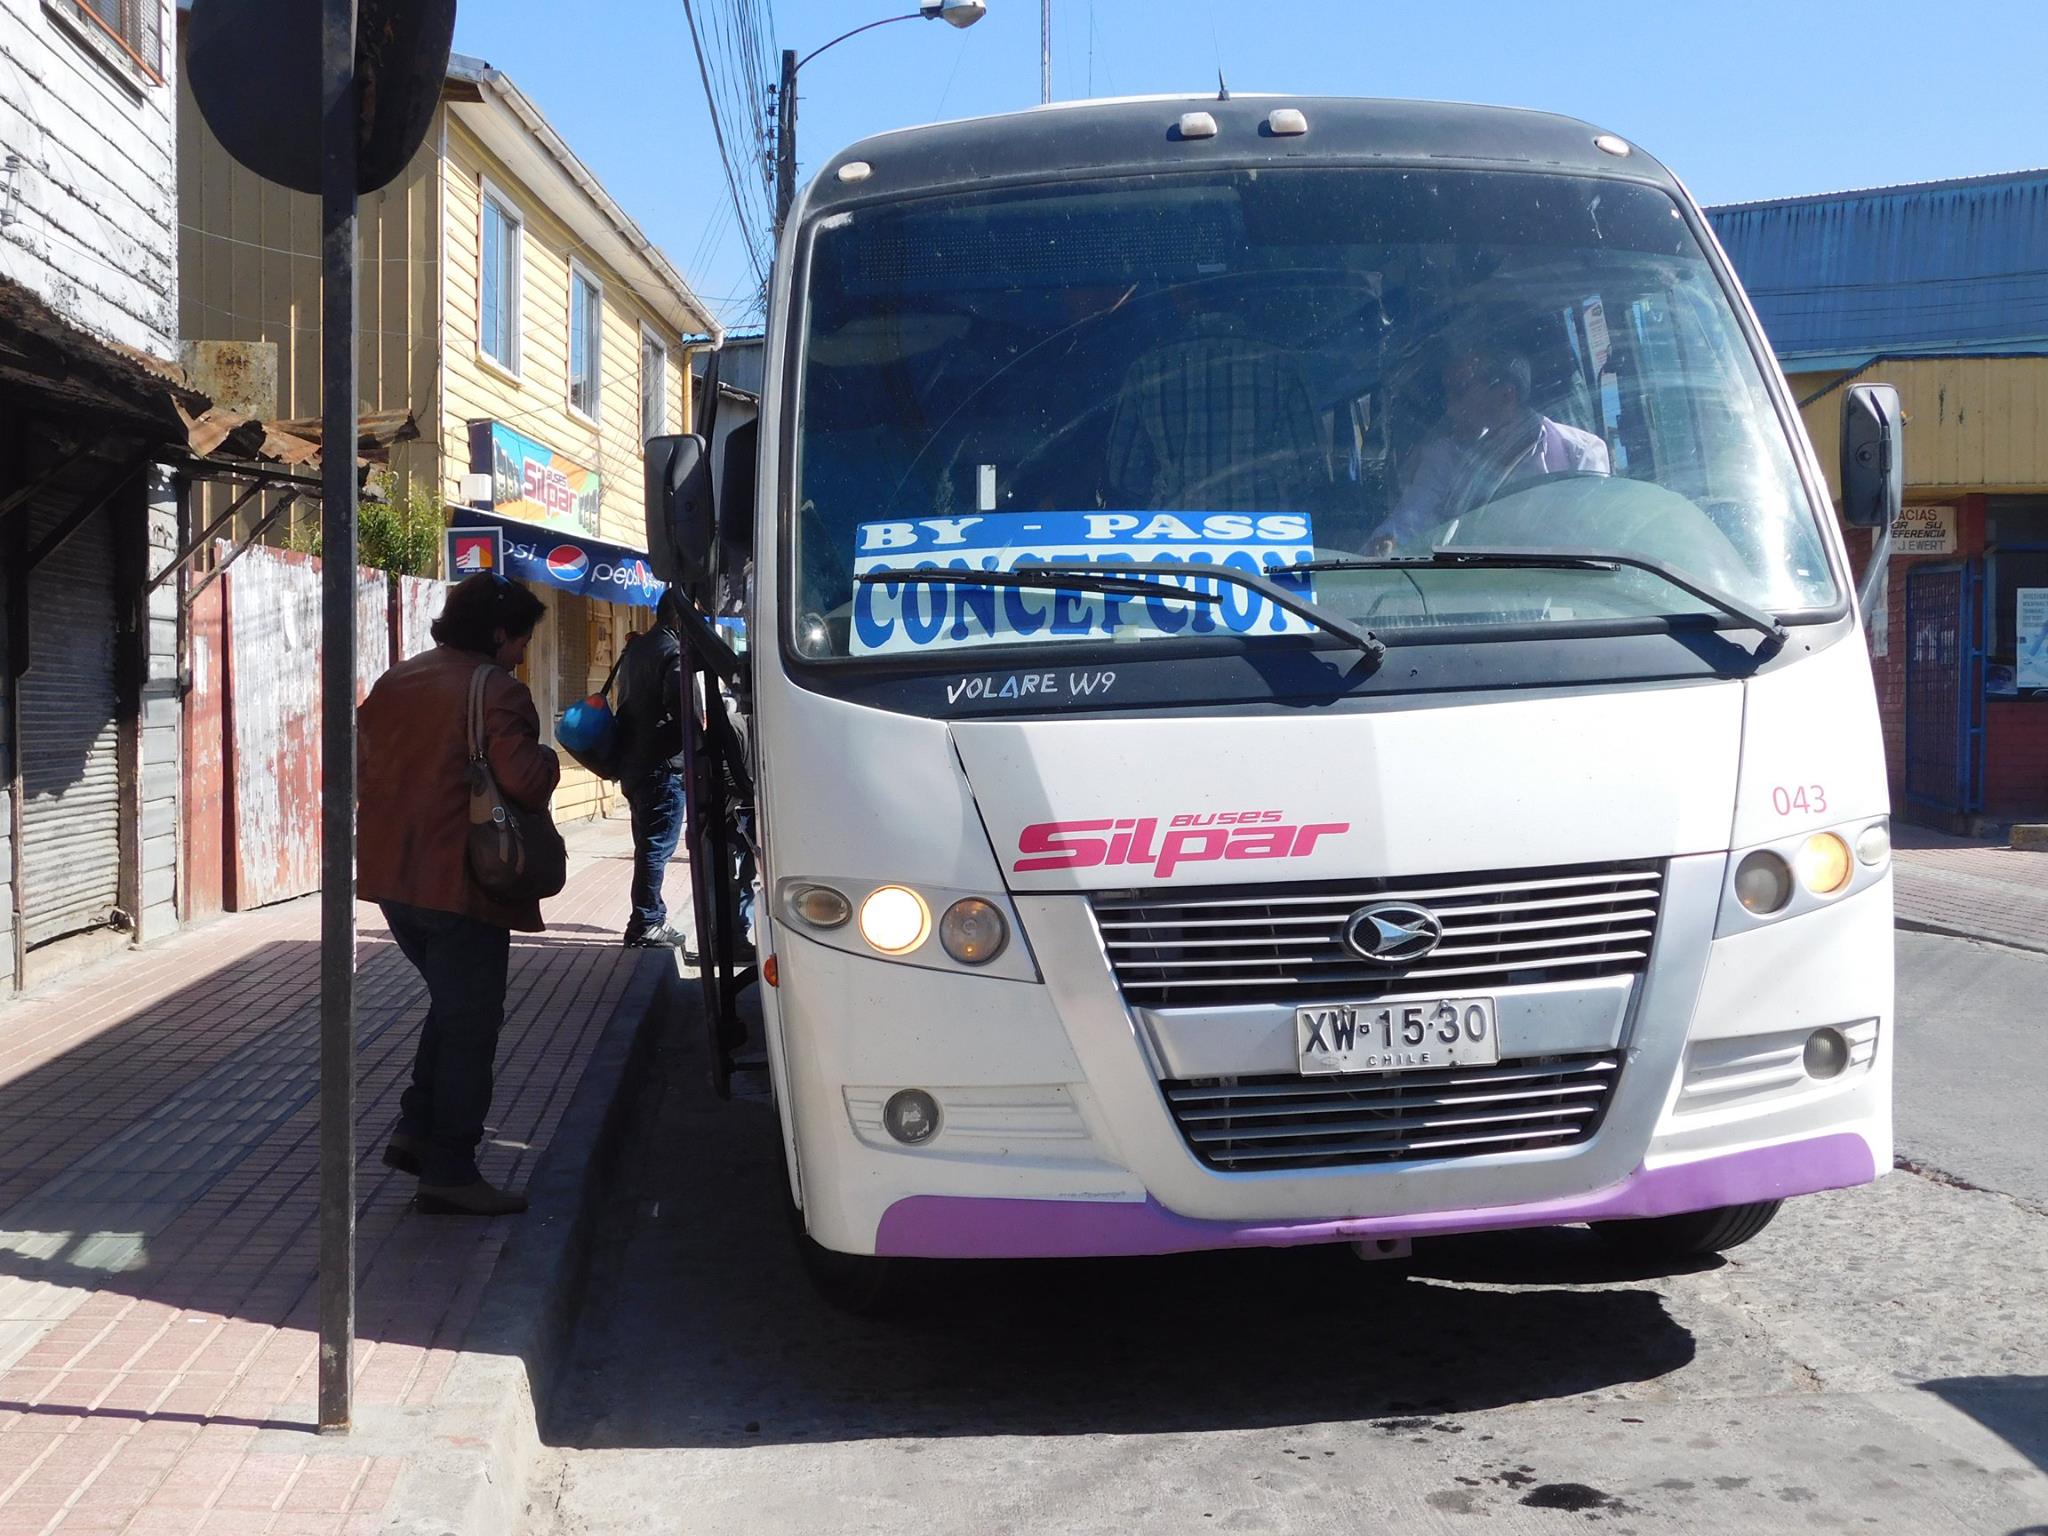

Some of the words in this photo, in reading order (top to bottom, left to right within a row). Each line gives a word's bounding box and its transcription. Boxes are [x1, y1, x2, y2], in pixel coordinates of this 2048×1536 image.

[524, 460, 577, 516] Silpar
[1891, 521, 1909, 530] OR
[1924, 521, 1943, 530] SU
[1898, 508, 1938, 521] ACIAS
[860, 518, 984, 550] BY
[1083, 514, 1307, 541] PASS
[1891, 529, 1946, 539] EFERENCIA
[854, 550, 1317, 649] CONCEPCION
[946, 673, 1058, 704] VOLARE
[1069, 671, 1116, 696] W9
[1772, 784, 1828, 816] 043
[1013, 822, 1351, 879] Silpar
[1367, 1051, 1432, 1067] CHILE
